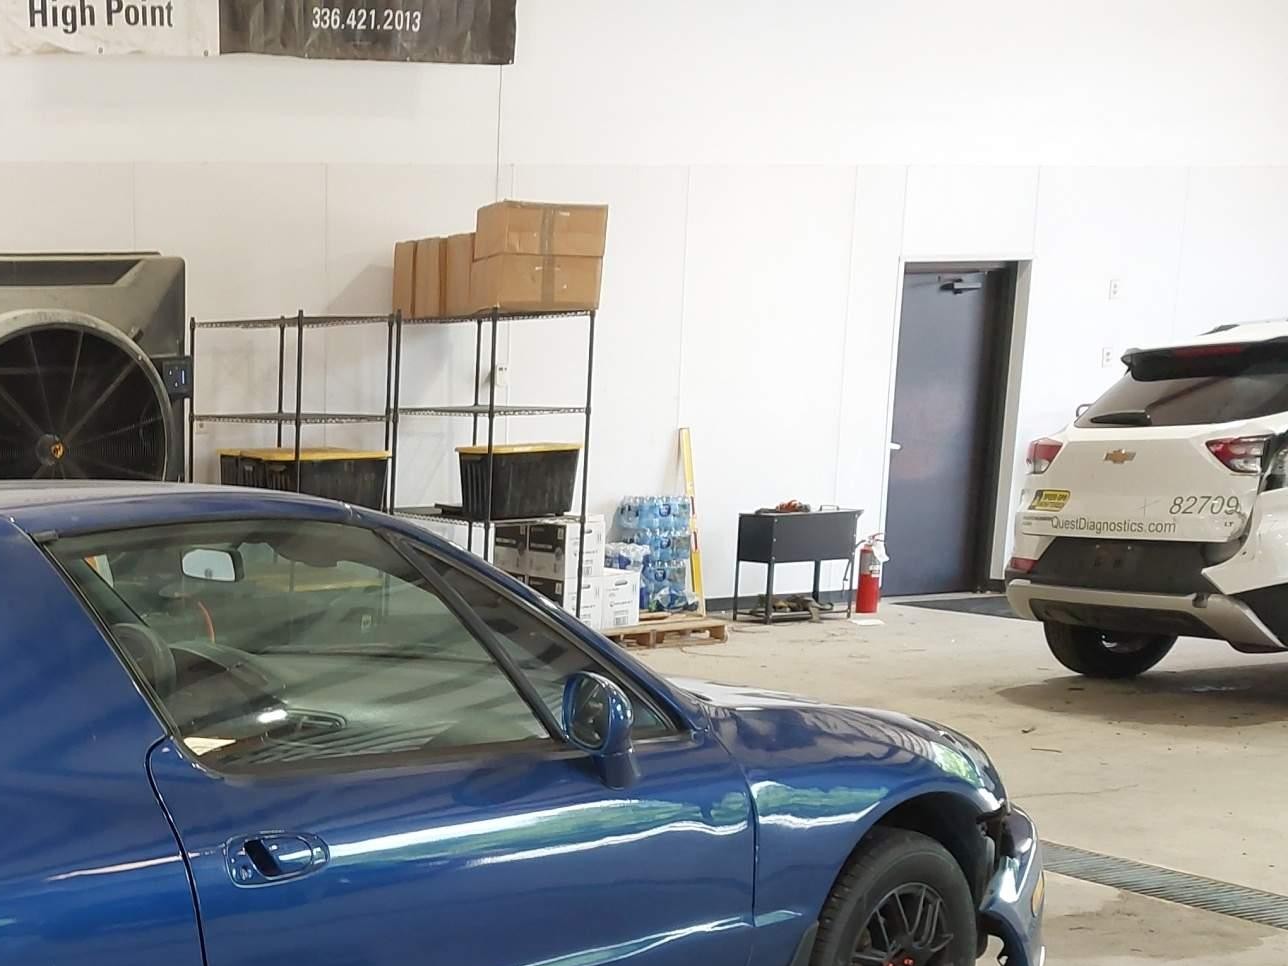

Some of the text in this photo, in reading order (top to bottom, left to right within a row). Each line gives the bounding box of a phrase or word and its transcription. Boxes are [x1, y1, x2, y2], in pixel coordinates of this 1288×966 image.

[28, 0, 174, 34] High Point
[311, 7, 422, 33] 336.421.2013
[1169, 495, 1240, 516] 82709
[1050, 515, 1176, 534] QuestDiagnostics.com
